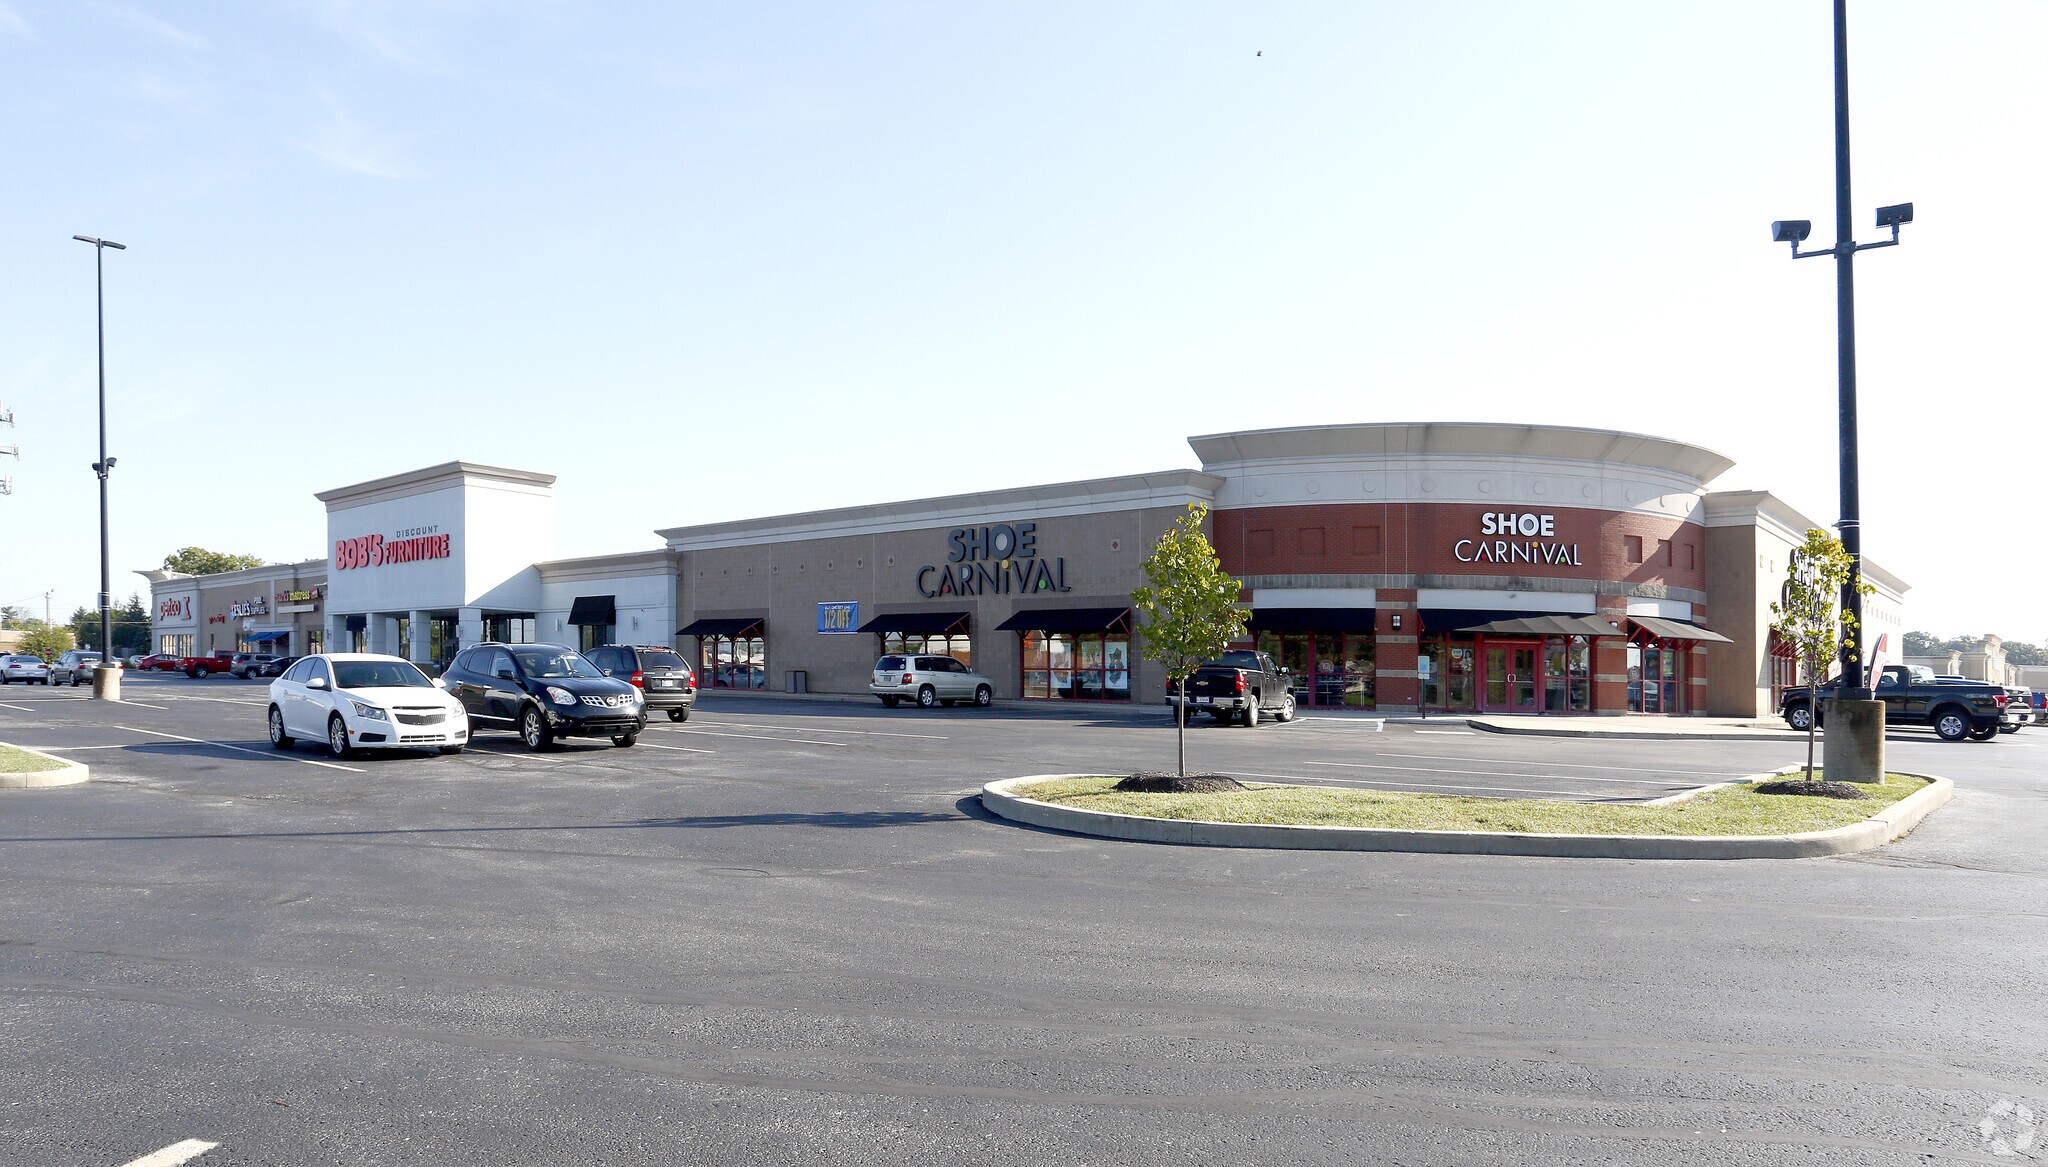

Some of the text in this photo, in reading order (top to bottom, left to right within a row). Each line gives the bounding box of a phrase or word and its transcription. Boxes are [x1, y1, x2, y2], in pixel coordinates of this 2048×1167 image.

[396, 524, 439, 539] DISCOUNT
[1481, 512, 1555, 537] SHOE
[335, 533, 450, 571] BOB'S FURNITURE
[947, 522, 1037, 563] SHOE
[159, 598, 182, 622] petco
[837, 609, 850, 628] OFF
